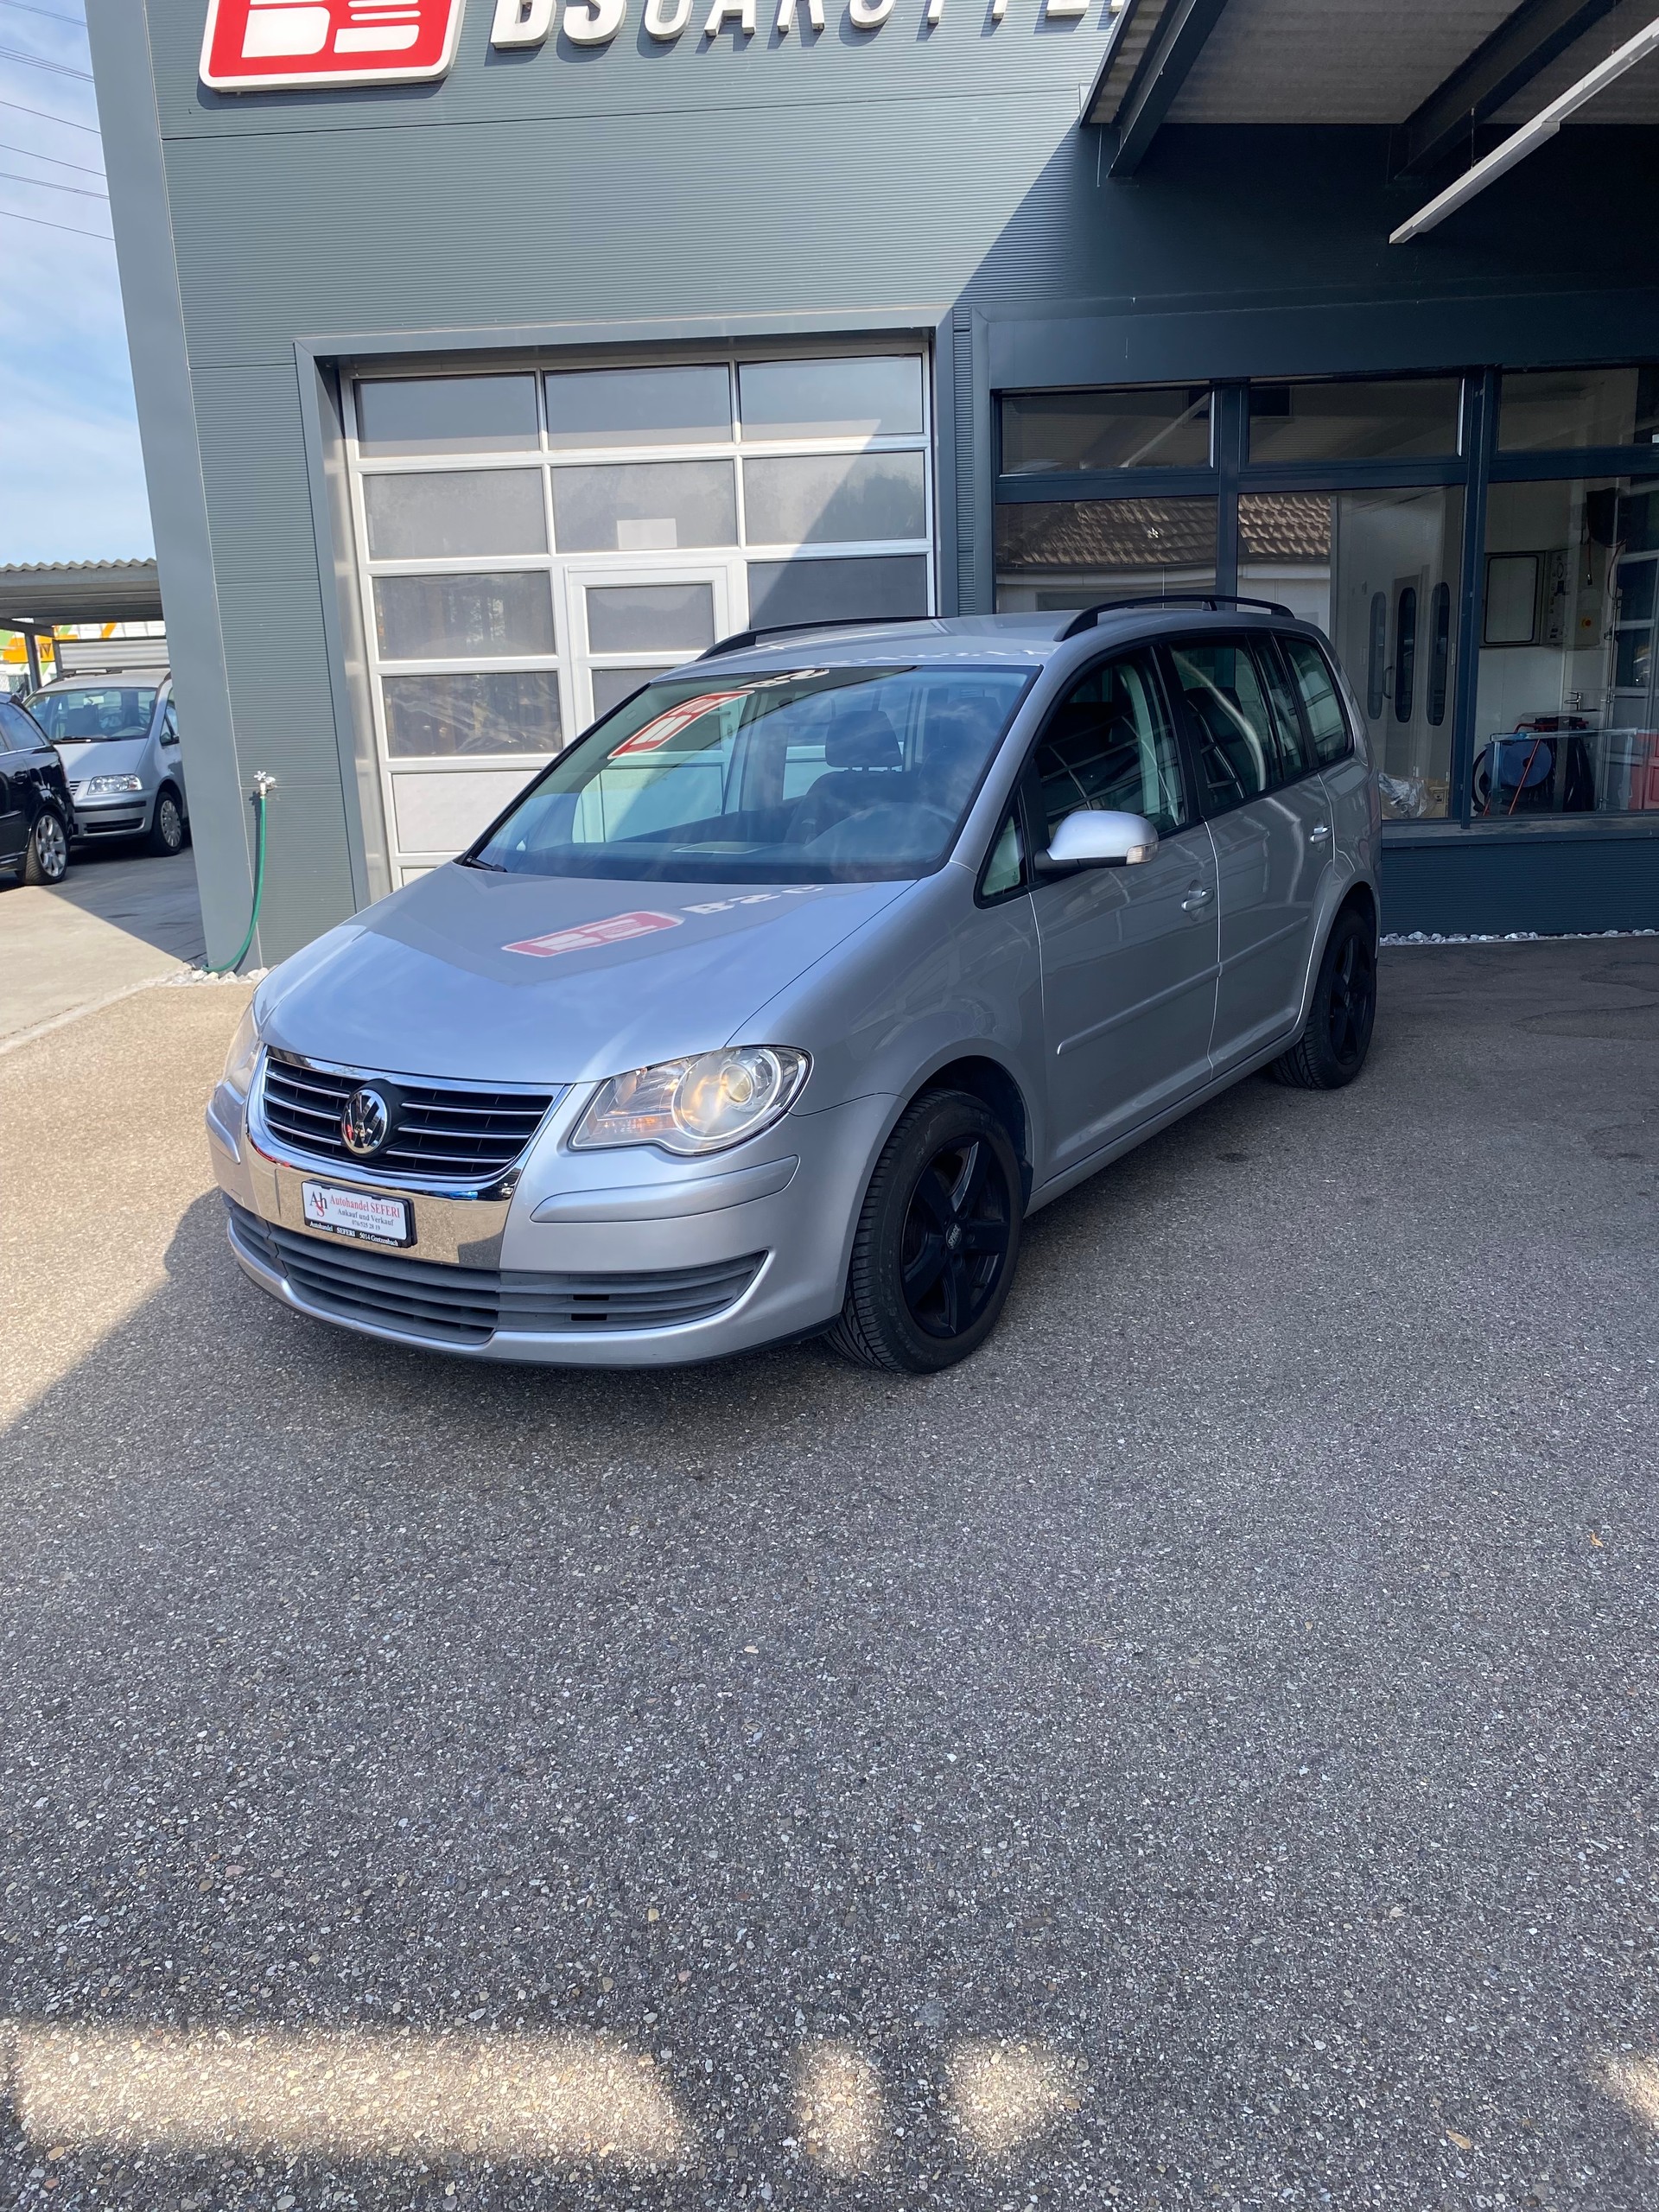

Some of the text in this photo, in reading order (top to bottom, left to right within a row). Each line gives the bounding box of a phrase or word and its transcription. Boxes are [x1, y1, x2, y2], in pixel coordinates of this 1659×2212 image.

[330, 1194, 401, 1218] Autohandel SEFERI
[338, 1208, 394, 1226] Ankauf und Verkauf
